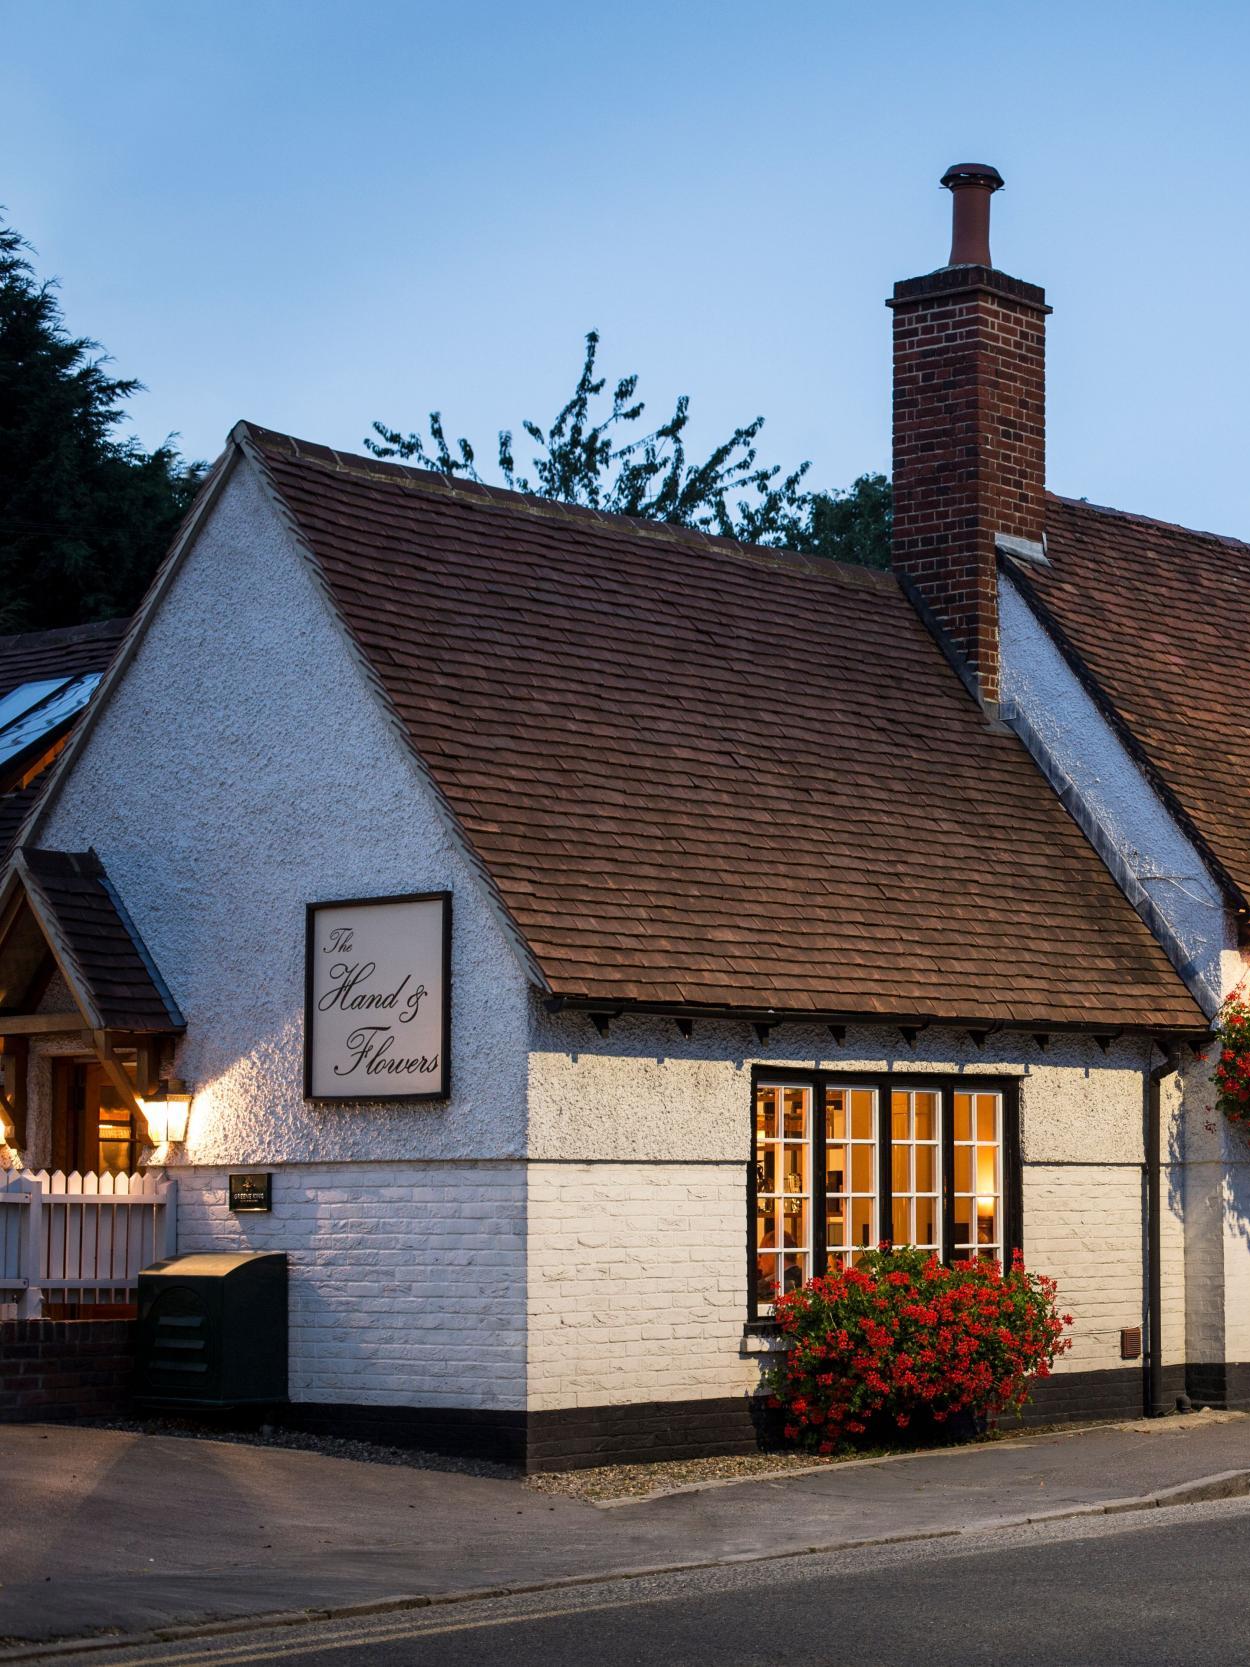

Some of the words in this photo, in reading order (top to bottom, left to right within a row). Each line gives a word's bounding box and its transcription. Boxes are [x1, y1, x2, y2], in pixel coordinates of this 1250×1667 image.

[323, 928, 354, 954] The
[318, 962, 411, 1012] Hand
[399, 984, 428, 1024] &
[333, 1026, 439, 1076] Flowers
